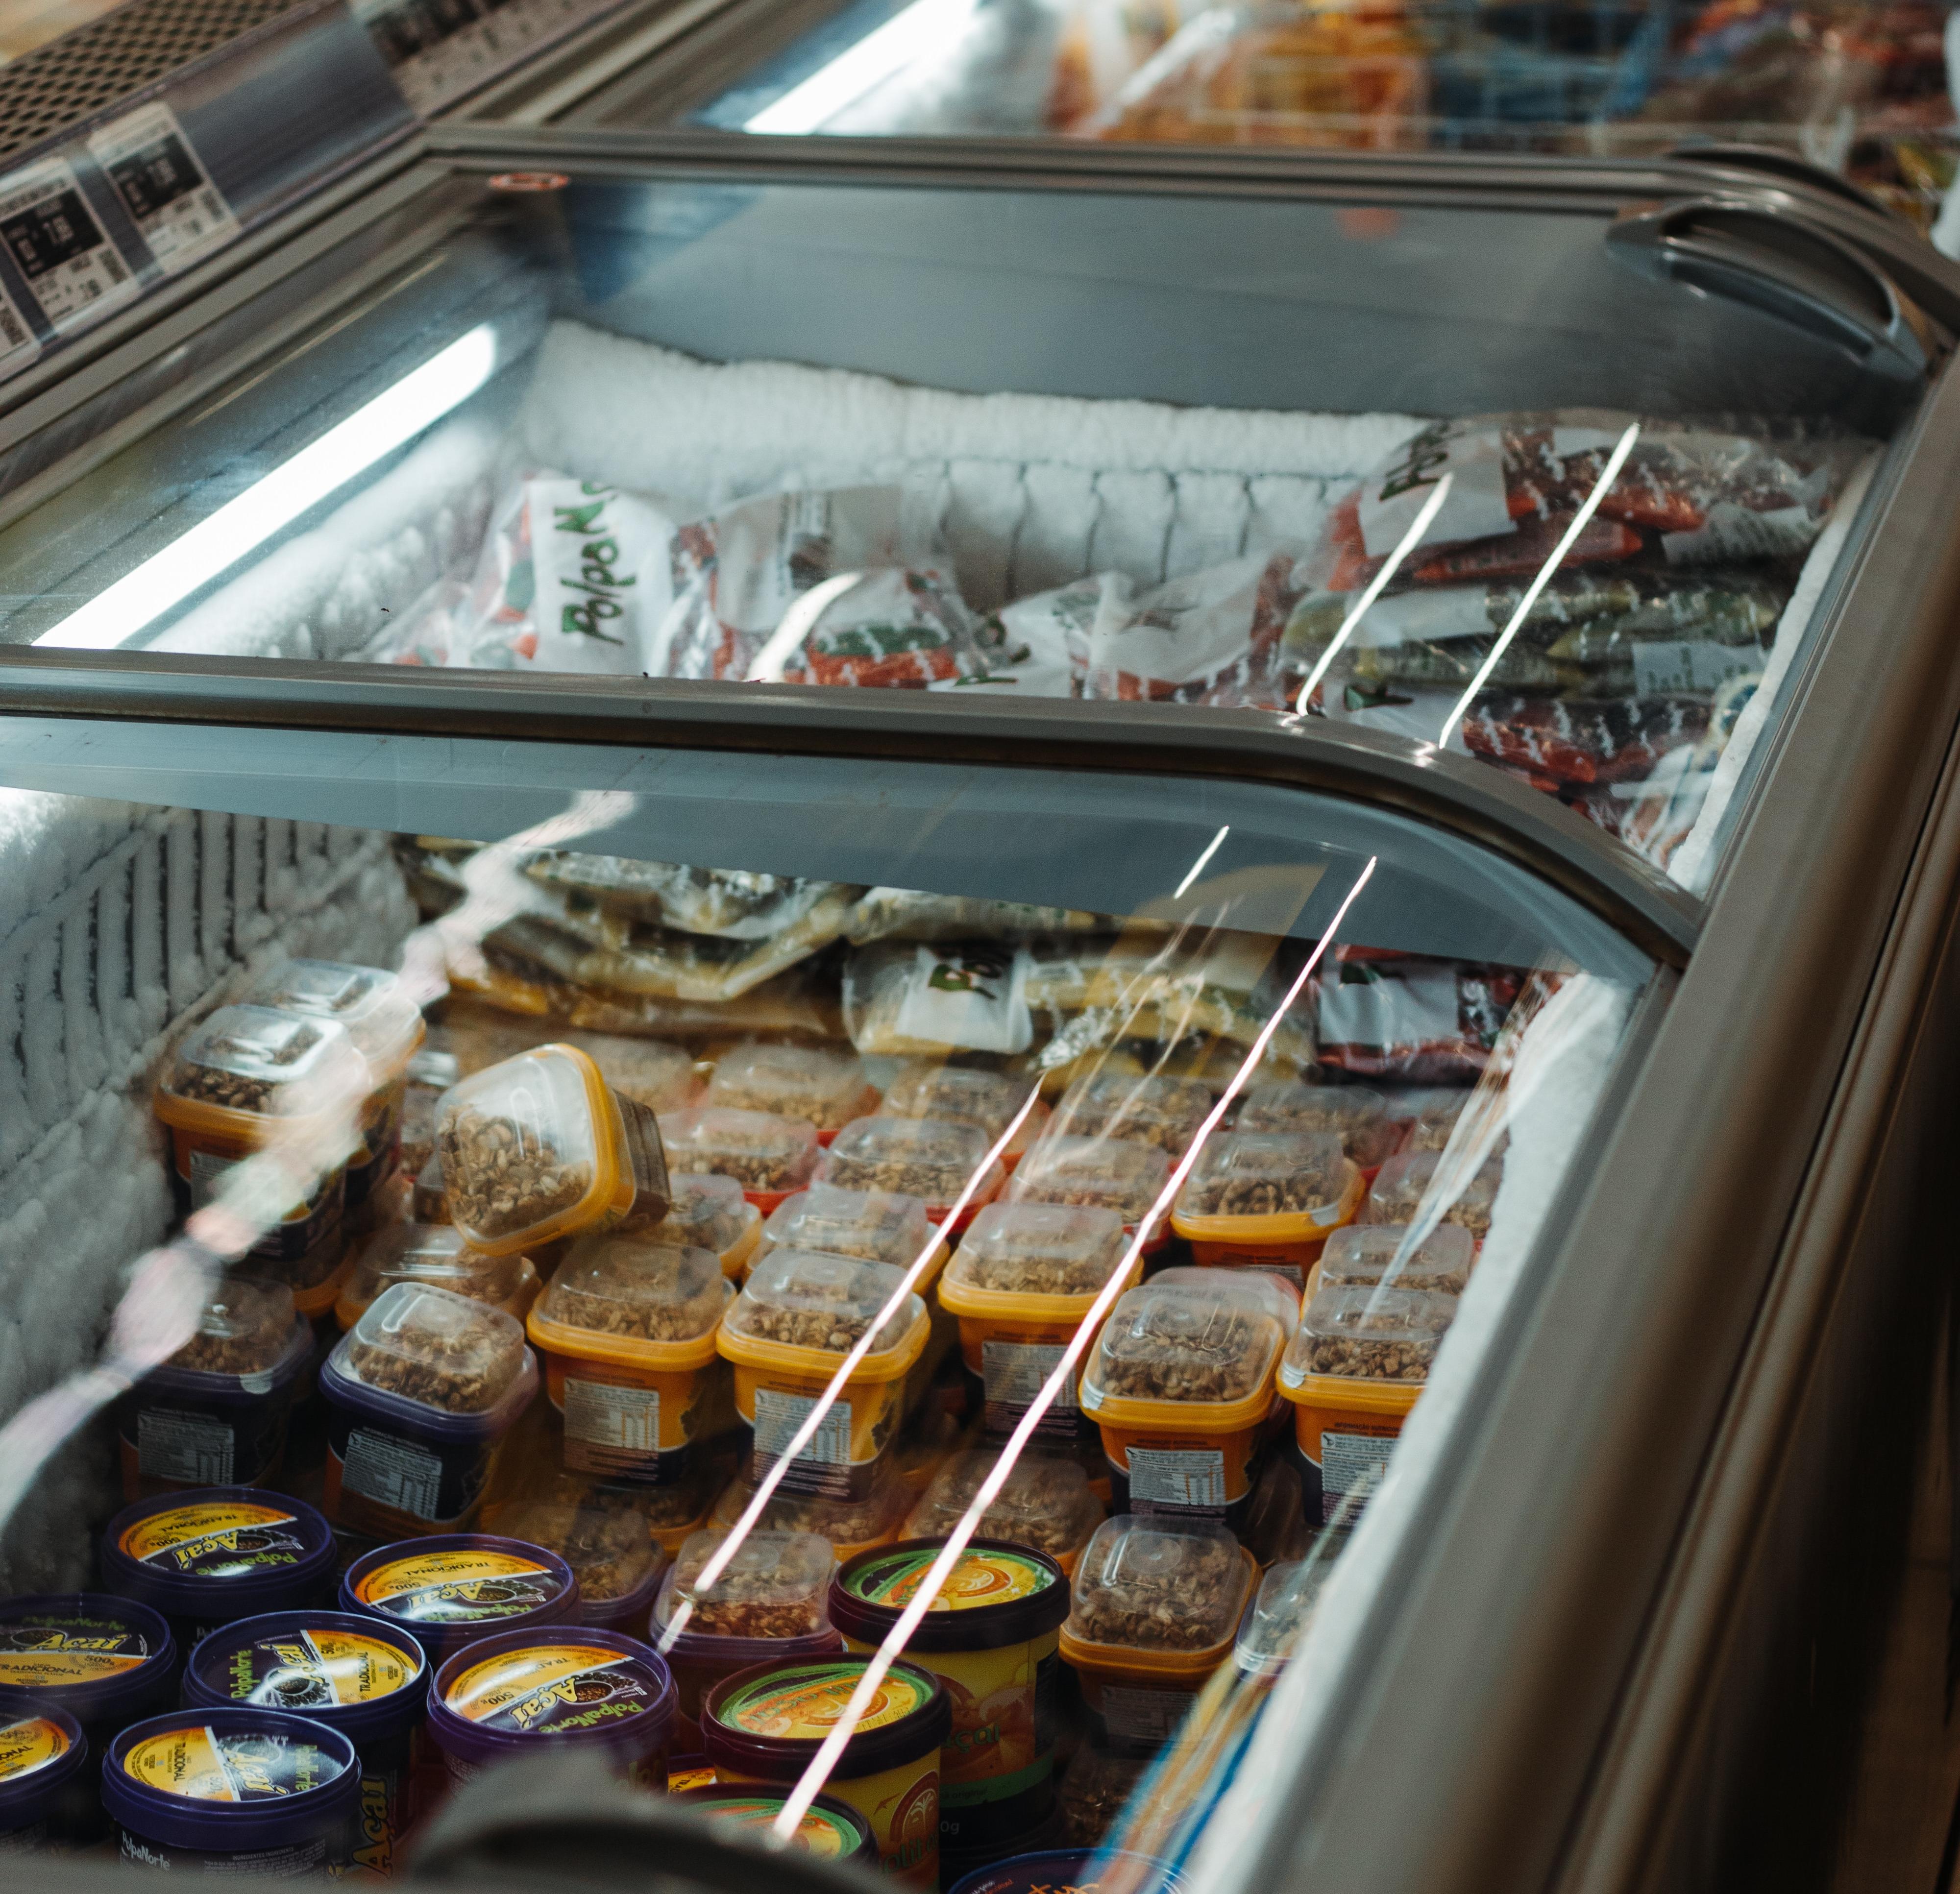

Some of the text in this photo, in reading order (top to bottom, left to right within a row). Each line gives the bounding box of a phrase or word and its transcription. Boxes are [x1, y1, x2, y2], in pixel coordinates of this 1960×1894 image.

[173, 1530, 239, 1569] Açaí
[402, 1560, 490, 1576] TRADICIONAL
[25, 1633, 131, 1652] Açaí
[0, 1664, 82, 1675] RADICIONAL
[480, 1691, 515, 1705] 500g
[510, 1677, 578, 1729] Açaí
[540, 1700, 645, 1733] PolpaNorte
[122, 1830, 171, 1871] PolpaNorte
